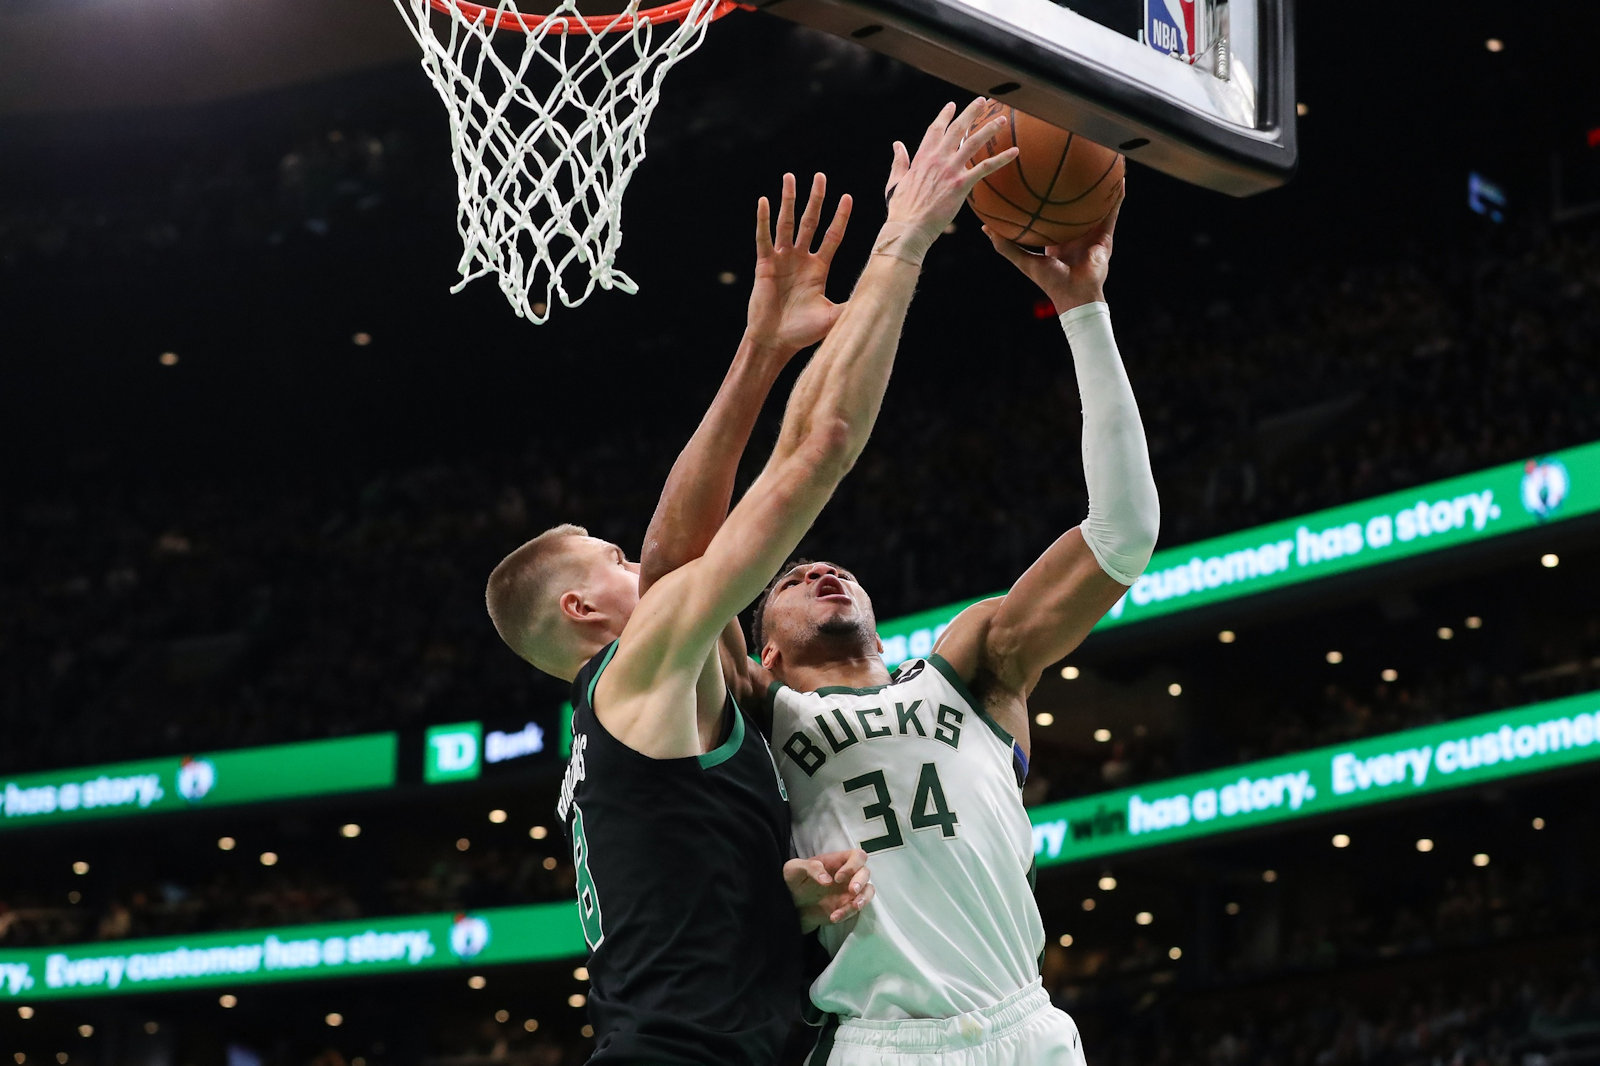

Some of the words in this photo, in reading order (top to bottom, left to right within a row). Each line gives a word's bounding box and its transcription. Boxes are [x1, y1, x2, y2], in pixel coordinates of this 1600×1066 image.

[1153, 18, 1178, 52] NBA
[1131, 539, 1294, 606] customer
[1296, 526, 1364, 566] has
[1365, 514, 1393, 549] a
[1395, 489, 1501, 541] story.
[430, 732, 477, 772] TD
[485, 721, 544, 763] Bank
[782, 699, 964, 778] BUCKS
[1331, 746, 1432, 795] Every
[4, 782, 57, 817] has
[59, 782, 79, 811] a
[841, 761, 961, 855] 34
[1071, 804, 1126, 844] win
[1128, 795, 1190, 835] has
[1192, 788, 1217, 822] a
[1219, 770, 1316, 817] story.
[46, 953, 125, 989] Every
[126, 944, 262, 982] customer
[264, 935, 320, 971] has
[323, 936, 346, 966] a
